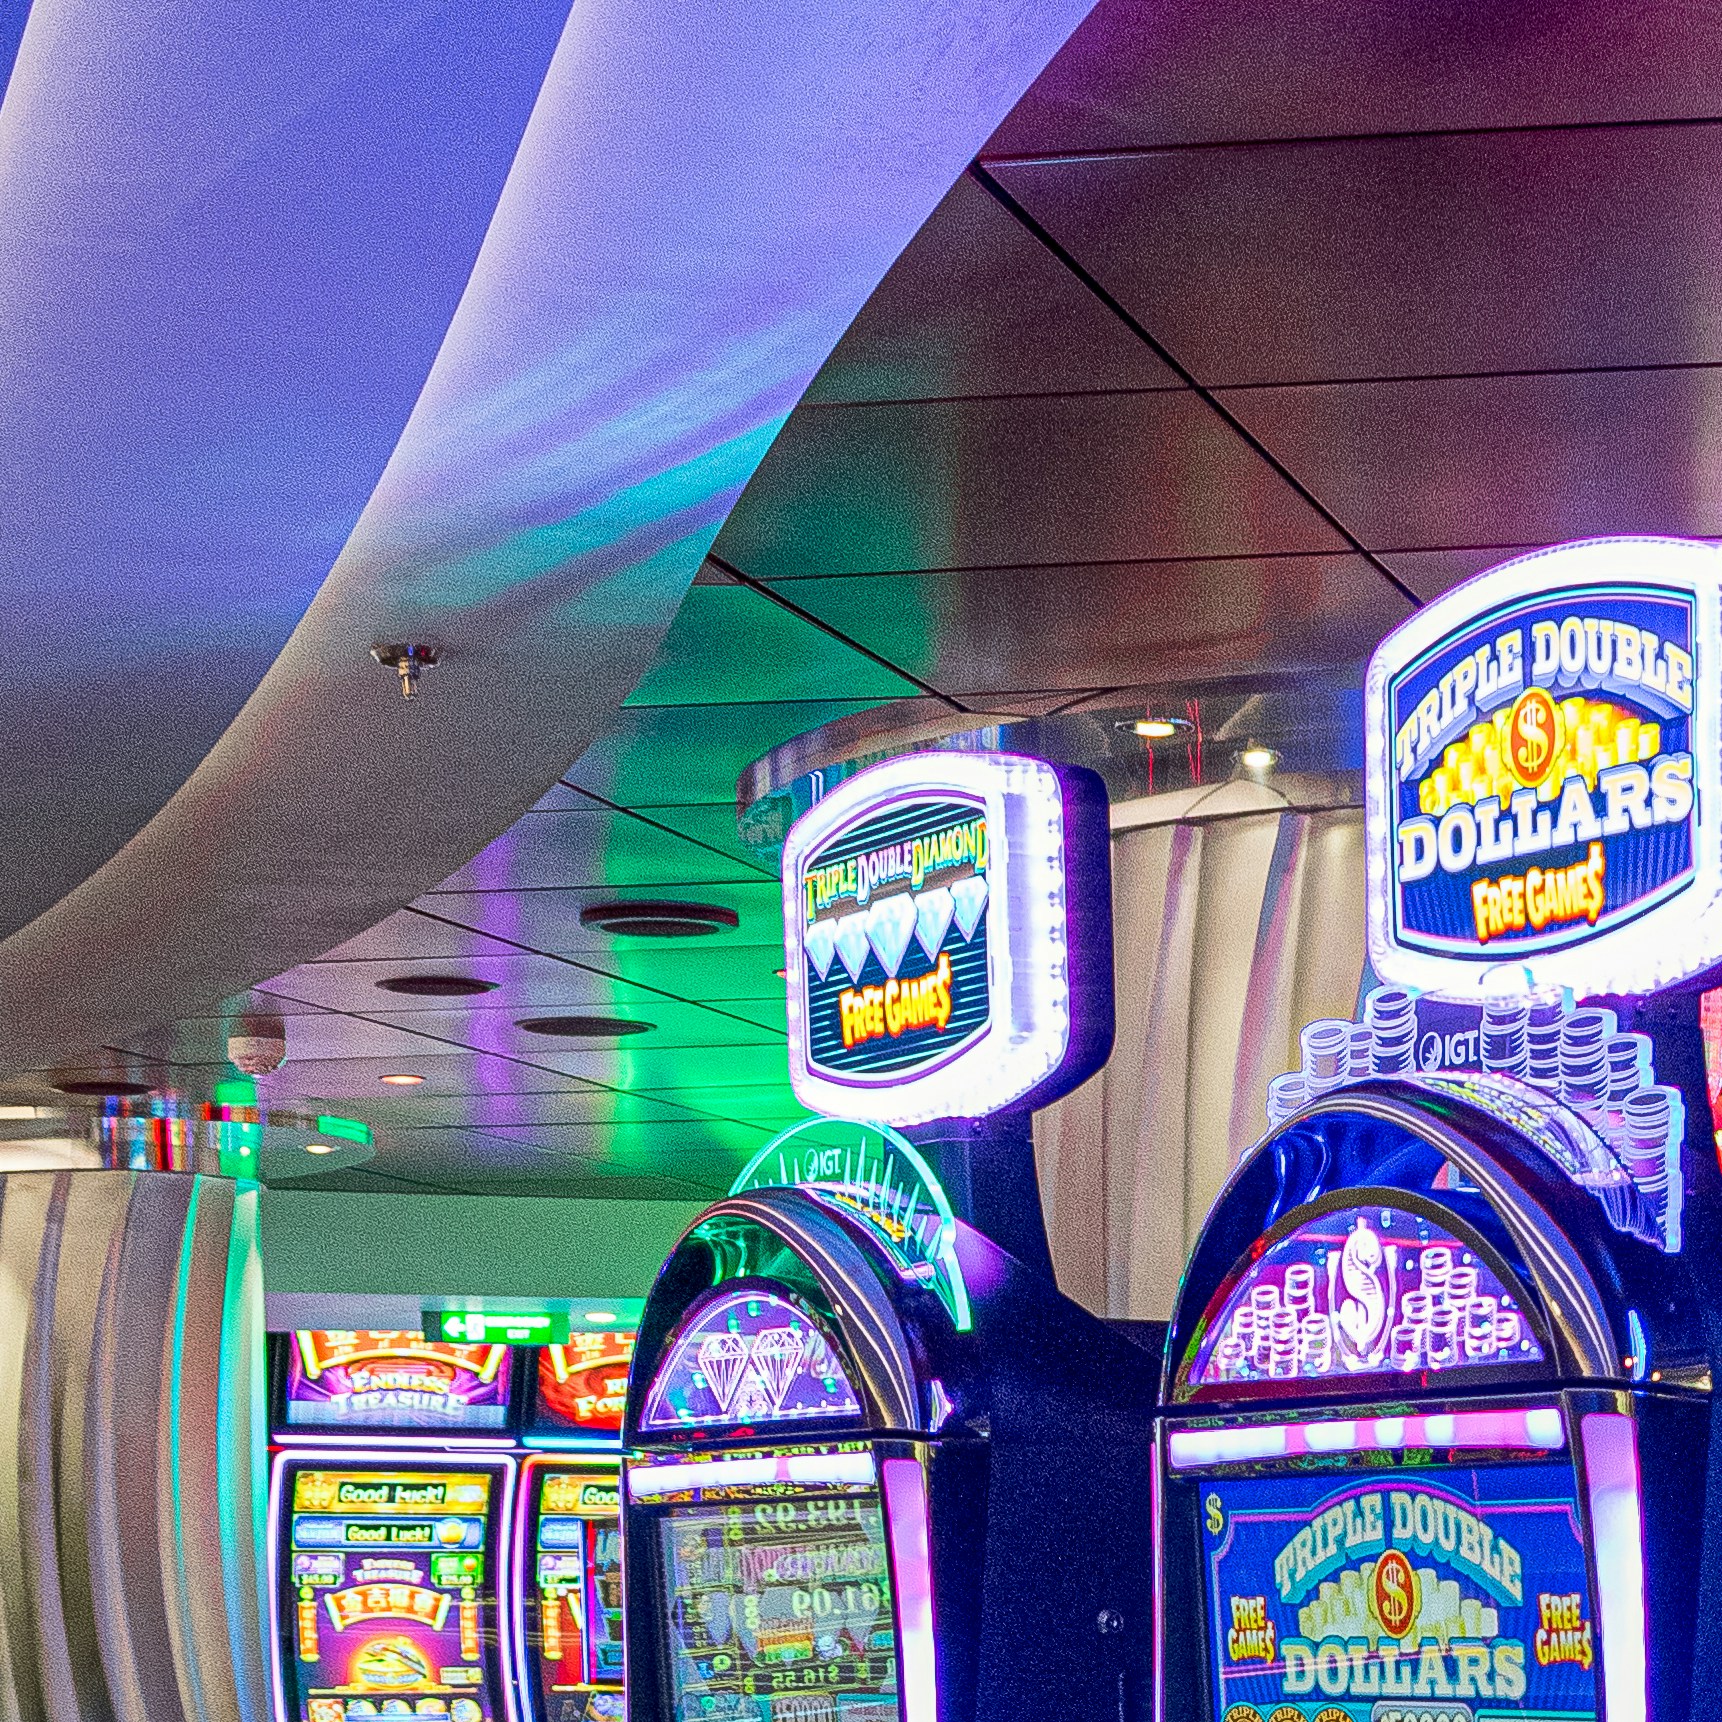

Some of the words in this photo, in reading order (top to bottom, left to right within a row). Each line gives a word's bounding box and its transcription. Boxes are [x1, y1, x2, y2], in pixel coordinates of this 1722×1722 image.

[1397, 629, 1522, 776] TRIPLE
[1532, 617, 1695, 716] DOUBLE
[1398, 752, 1694, 883] DOLLARS
[1472, 877, 1526, 945] FREE
[840, 987, 886, 1049] FREE
[1445, 1031, 1479, 1064] IGT
[820, 1149, 842, 1177] IGT
[339, 1484, 389, 1504] Good
[395, 1485, 446, 1504] Luck!
[347, 1525, 387, 1541] Good
[391, 1524, 431, 1542] Luck!
[1274, 1493, 1385, 1597] TRIPLE
[1391, 1491, 1524, 1602] DOUBLE
[1231, 1596, 1266, 1628] FREE
[1538, 1593, 1581, 1632] FREE
[1280, 1637, 1526, 1699] DOLLARS
